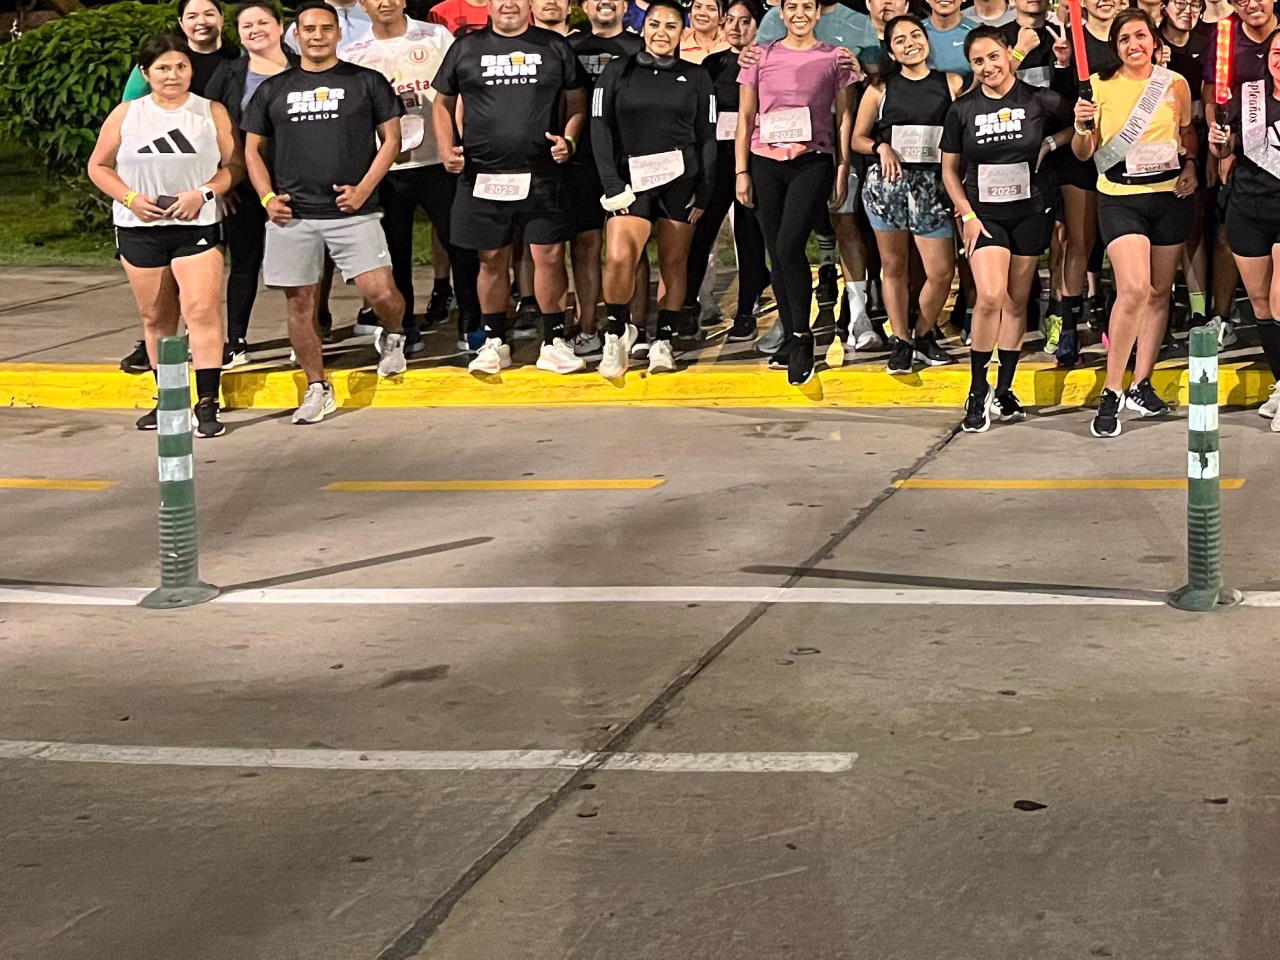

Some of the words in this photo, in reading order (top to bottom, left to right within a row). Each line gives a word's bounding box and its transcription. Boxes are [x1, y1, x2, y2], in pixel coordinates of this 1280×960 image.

[414, 50, 424, 61] U
[481, 51, 543, 67] BEER
[482, 63, 537, 77] RUN
[495, 76, 528, 86] PERÚ
[286, 86, 345, 104] BEER
[287, 99, 339, 115] RUN
[300, 112, 330, 122] PERÚ
[974, 107, 1026, 127] BEER
[975, 119, 1022, 137] RUN
[1119, 115, 1146, 145] HAPPY
[774, 131, 799, 140] 2025
[904, 147, 929, 157] 2025
[489, 184, 514, 195] 2025
[991, 186, 1017, 197] 2025
